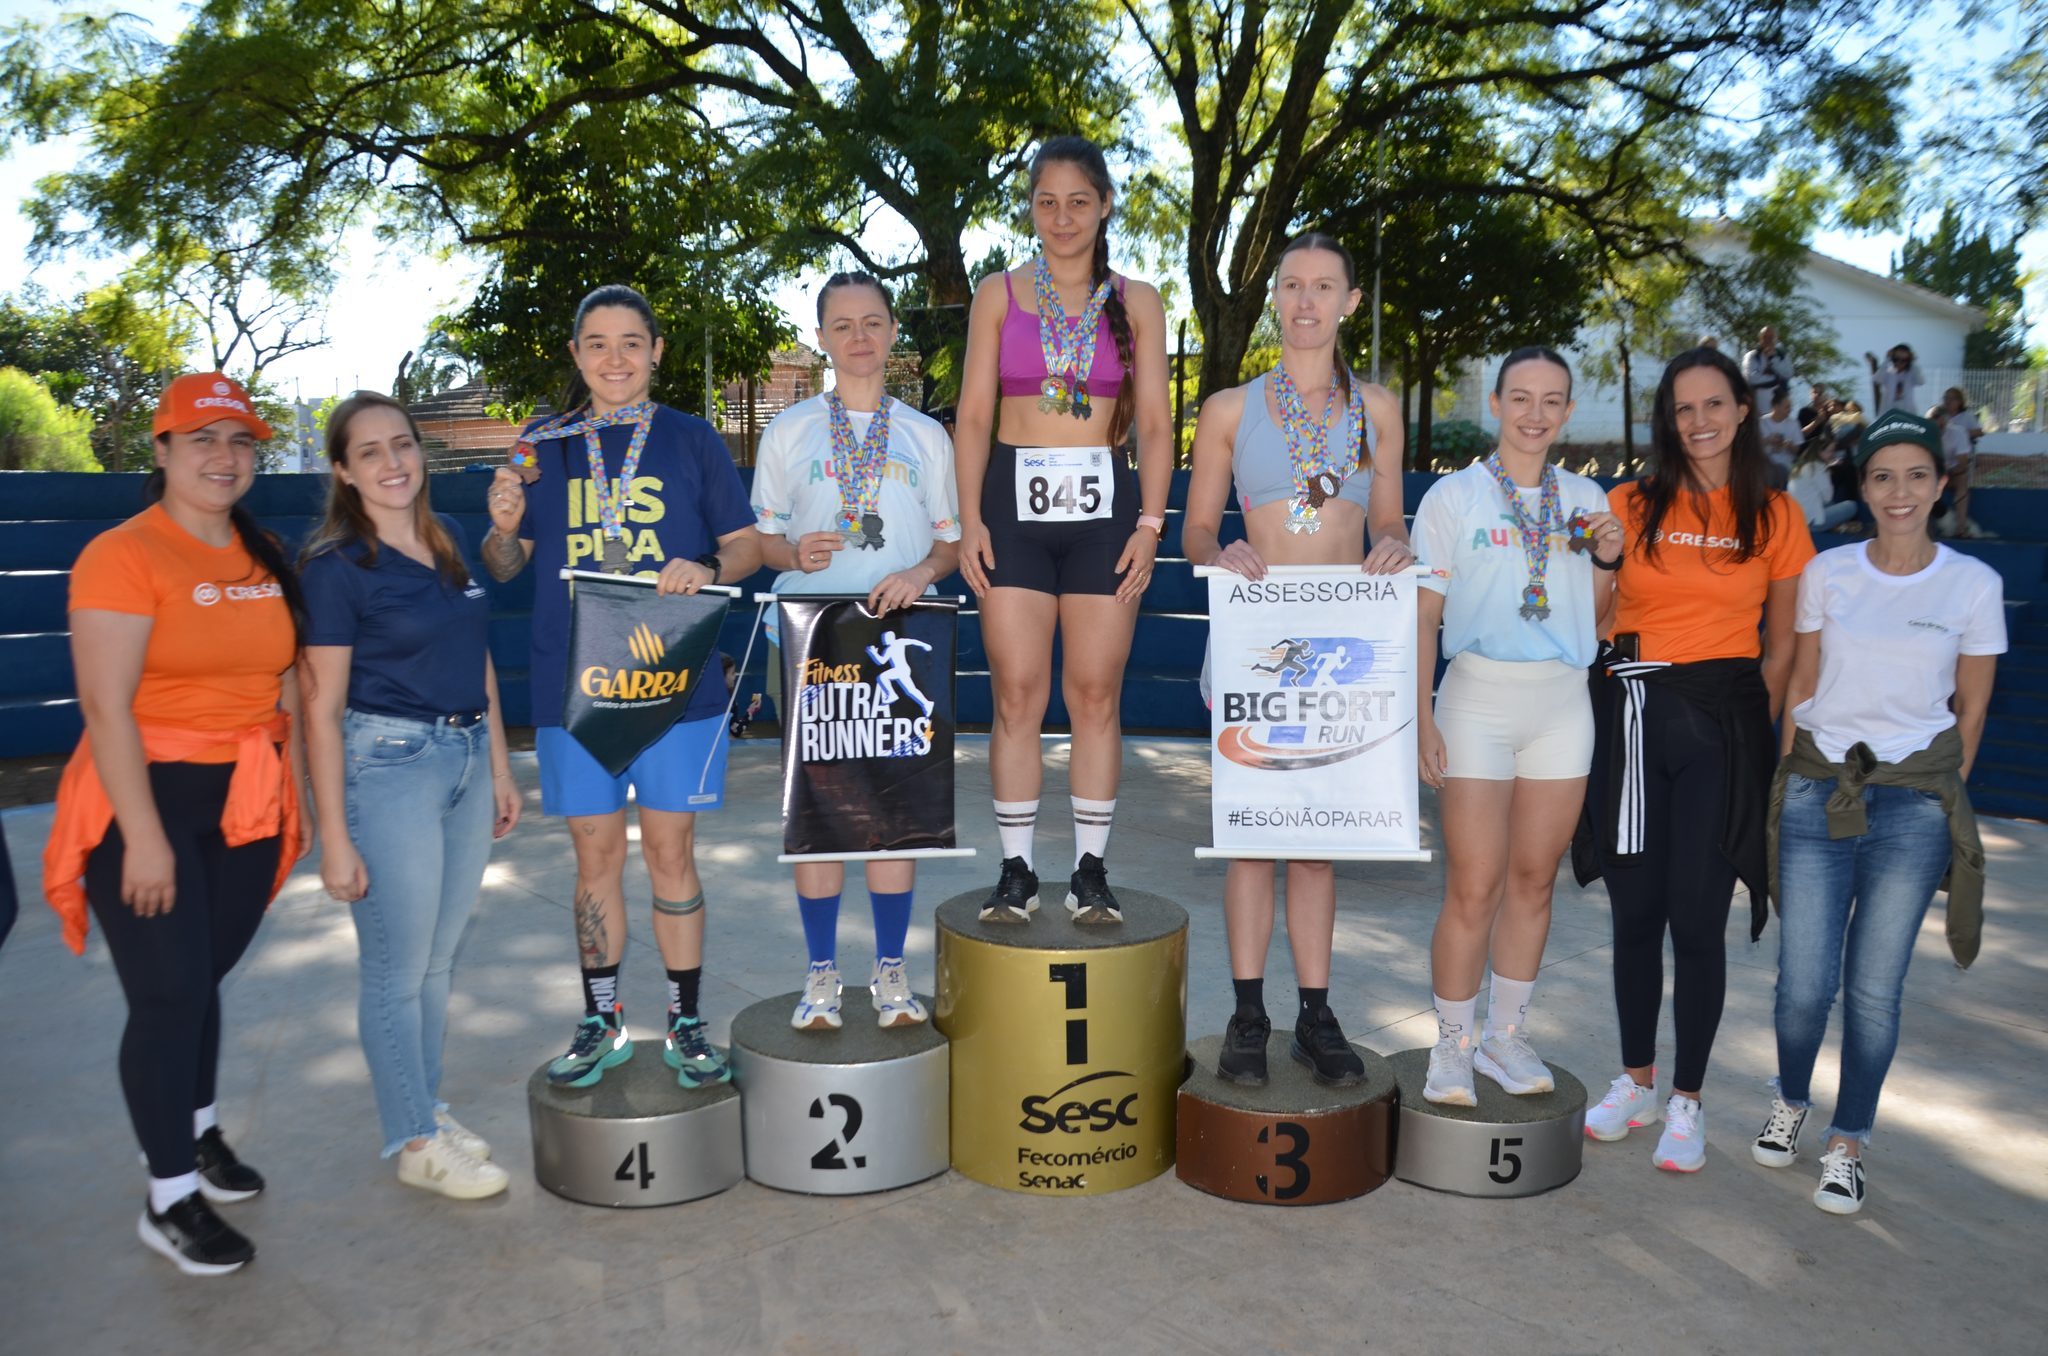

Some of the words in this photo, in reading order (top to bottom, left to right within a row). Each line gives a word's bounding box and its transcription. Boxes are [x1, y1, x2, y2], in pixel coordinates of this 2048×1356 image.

[1029, 475, 1101, 515] 845
[1228, 581, 1398, 604] ASSESSORIA
[580, 665, 689, 700] GARRA
[796, 658, 861, 689] Fitness
[801, 682, 891, 723] DUTRA
[1223, 691, 1288, 723] BIG
[1298, 690, 1395, 722] FORT
[801, 717, 932, 761] RUNNERS
[1317, 725, 1366, 744] RUN
[1228, 806, 1403, 828] #ÉSÓNÃOPARAR
[589, 976, 617, 1013] RUN
[1049, 963, 1088, 1065] 1
[809, 1093, 867, 1170] 2
[614, 1141, 656, 1190] 4
[1017, 1142, 1138, 1167] Fecomércio
[1255, 1121, 1311, 1200] 3
[1487, 1137, 1524, 1184] 5
[1018, 1172, 1086, 1189] Senac
